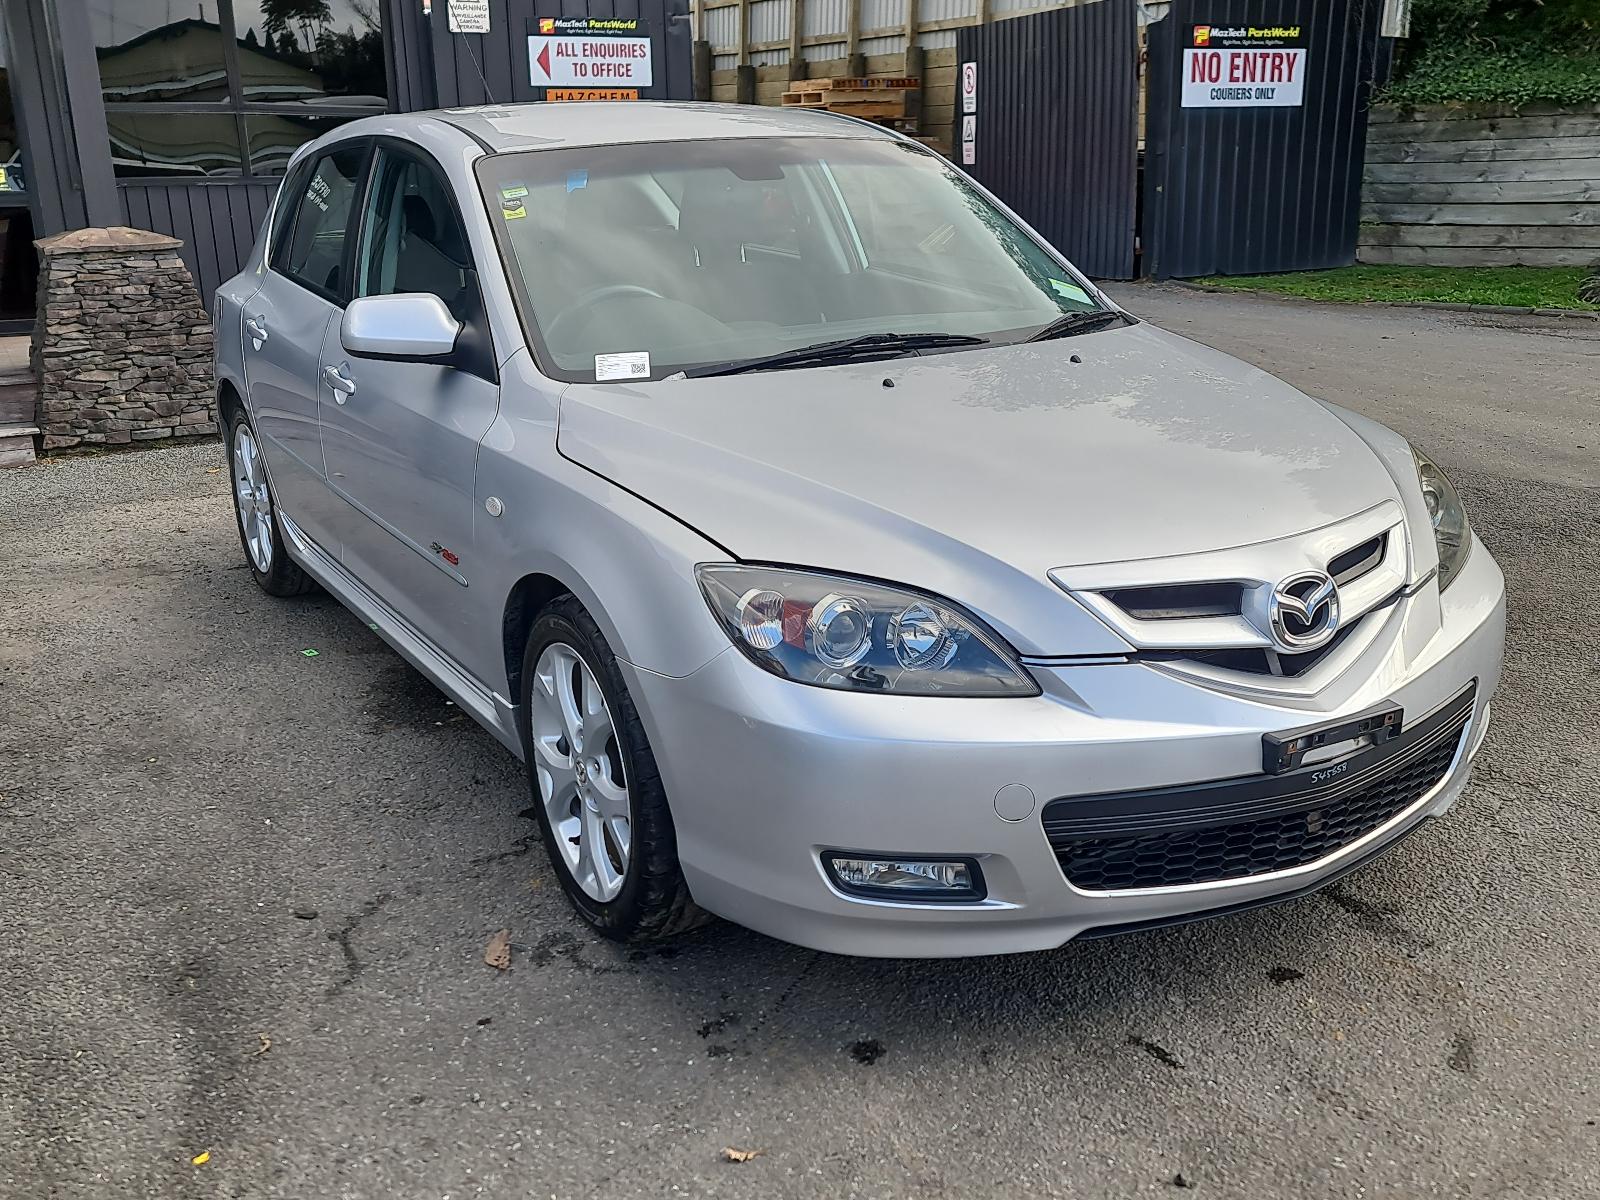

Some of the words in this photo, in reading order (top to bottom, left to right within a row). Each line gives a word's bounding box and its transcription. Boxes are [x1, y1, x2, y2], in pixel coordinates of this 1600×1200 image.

[589, 19, 637, 29] PartsWorld
[1248, 26, 1300, 37] PartsWorld
[556, 42, 578, 57] ALL
[582, 42, 646, 59] ENQUIRIES
[572, 62, 588, 77] TO
[591, 62, 632, 77] OFFICE
[1191, 52, 1221, 83] NO
[1229, 52, 1298, 83] ENTRY
[555, 92, 630, 101] HAZCHEM
[1210, 88, 1252, 100] COURIERS
[1254, 87, 1276, 100] ONLY
